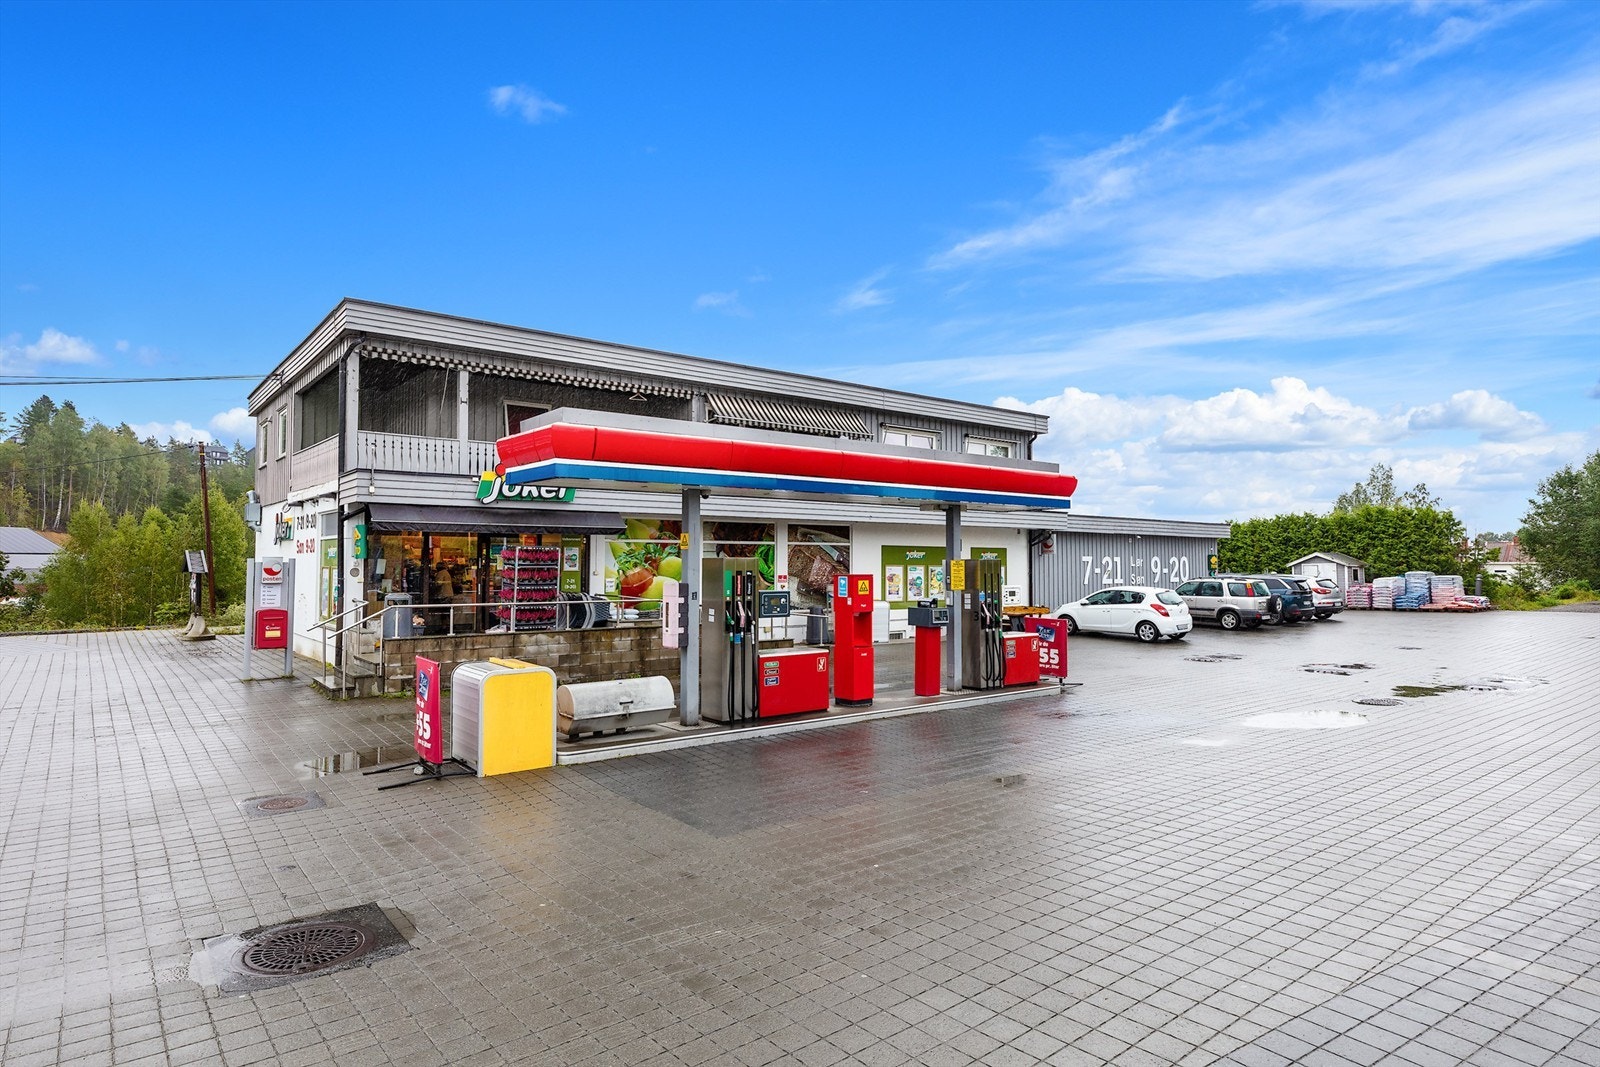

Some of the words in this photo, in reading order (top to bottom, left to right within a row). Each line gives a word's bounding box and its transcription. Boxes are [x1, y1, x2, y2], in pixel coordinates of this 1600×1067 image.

[906, 550, 926, 560] joker
[1130, 555, 1144, 567] Lør
[1082, 556, 1124, 585] 7-21
[1150, 556, 1190, 583] 9-20
[1130, 574, 1145, 585] Søn
[974, 611, 980, 621] 3
[1039, 647, 1060, 665] 55
